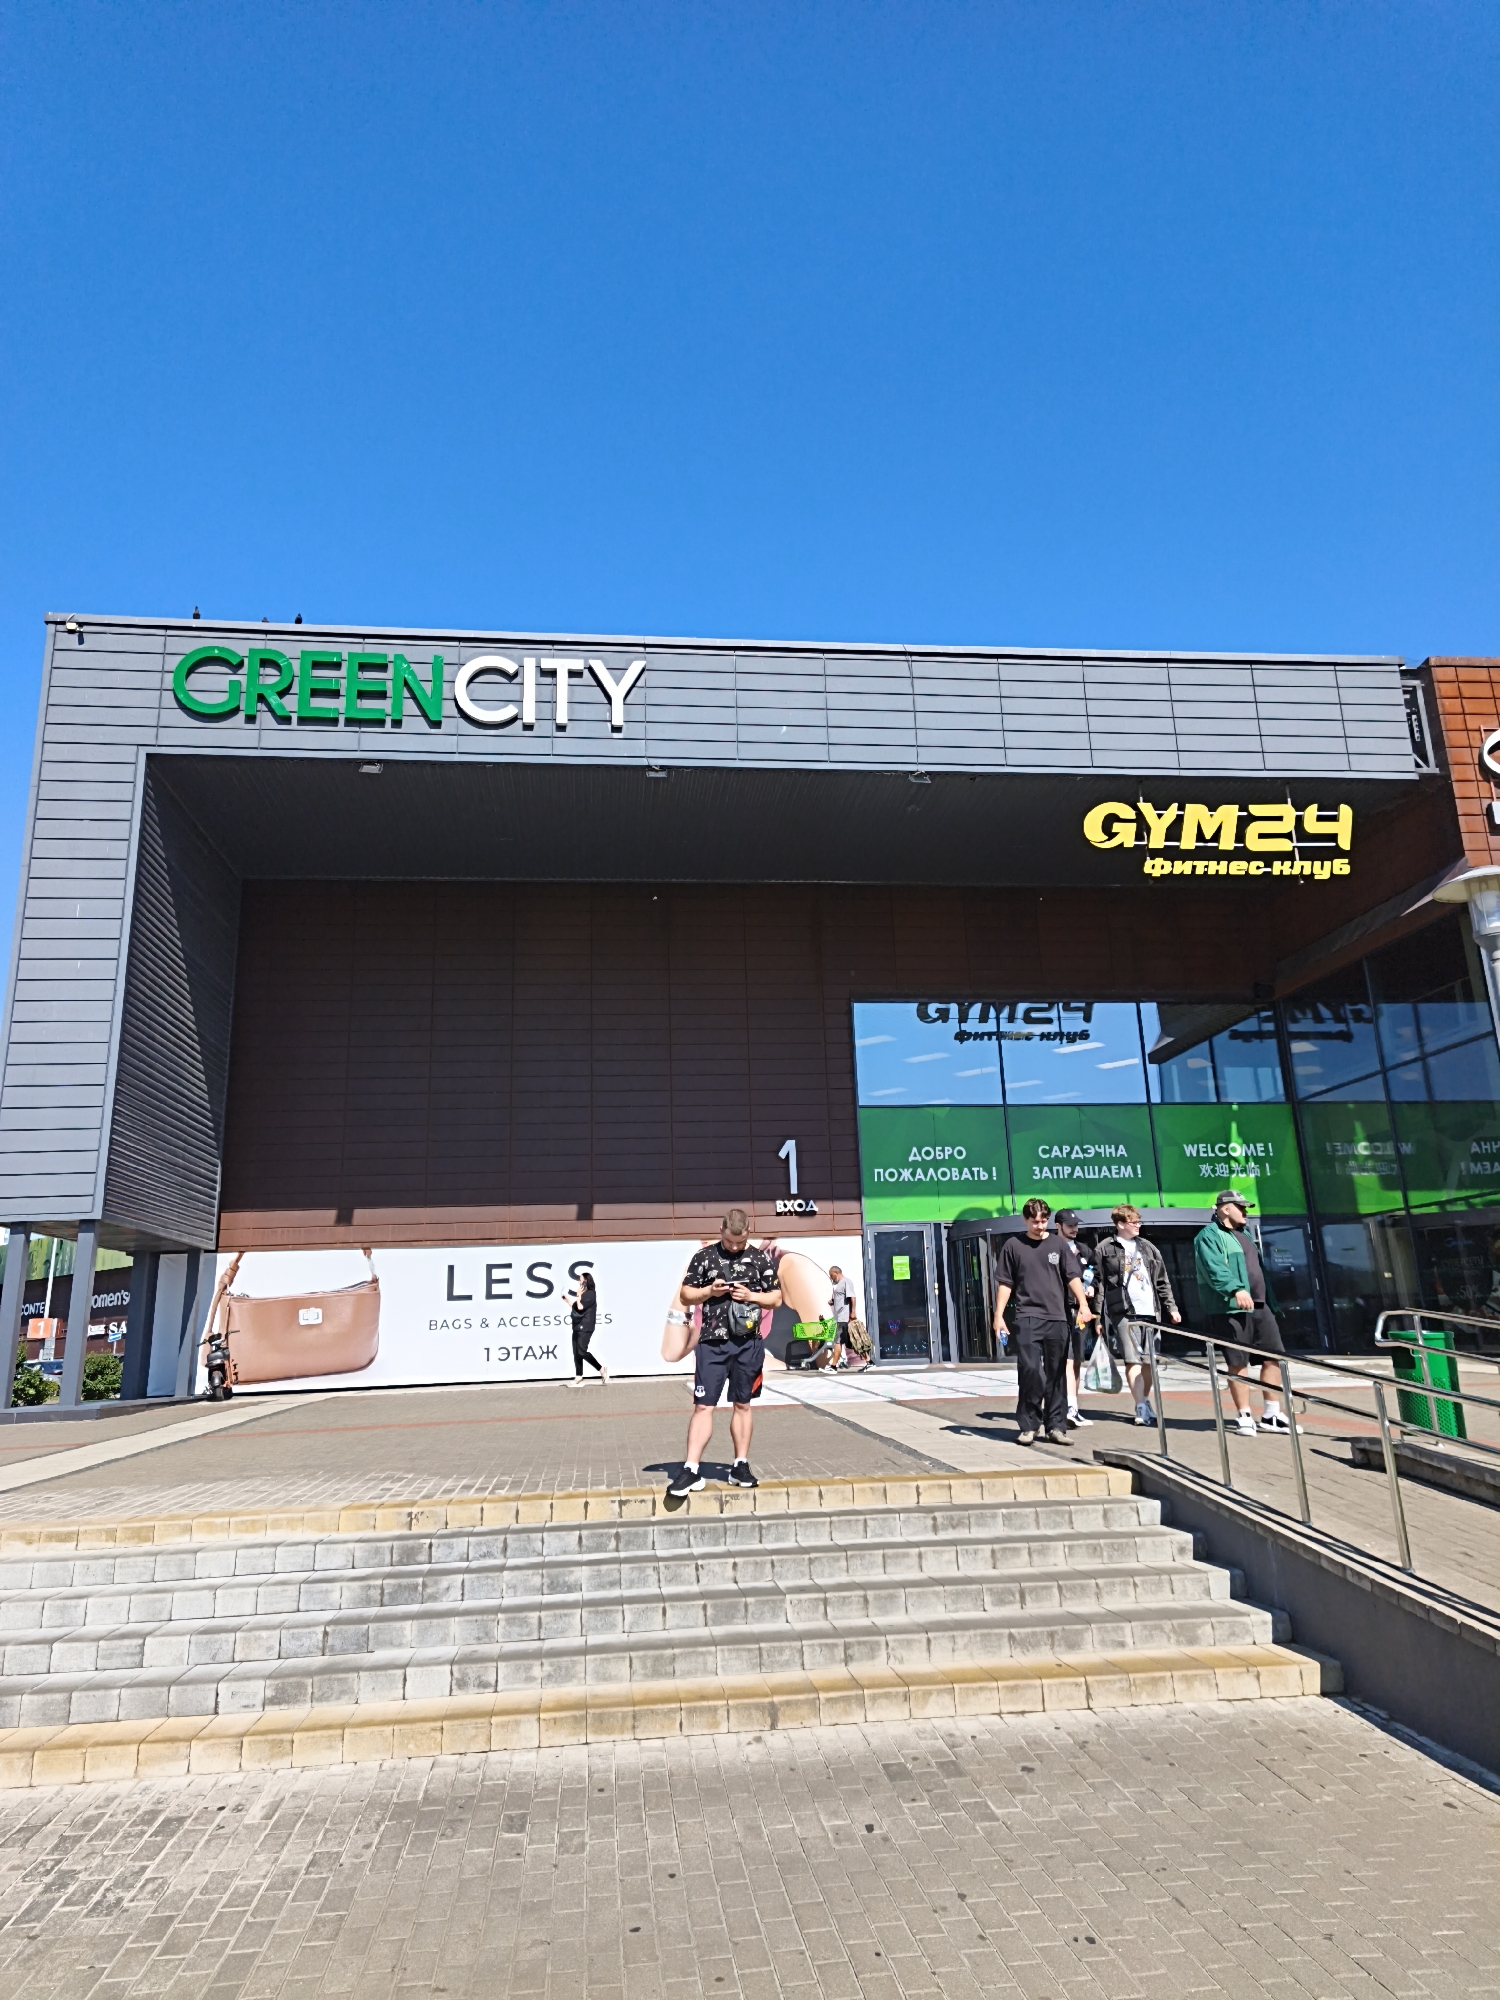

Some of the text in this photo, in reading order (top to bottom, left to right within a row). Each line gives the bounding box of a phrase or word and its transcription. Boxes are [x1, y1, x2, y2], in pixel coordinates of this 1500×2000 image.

[1083, 801, 1353, 852] GYM24
[908, 1146, 967, 1161] ДОБРО
[1038, 1144, 1128, 1160] САРДЭЧНА
[778, 1139, 798, 1194] 1
[775, 1199, 818, 1213] ВХОД
[446, 1260, 594, 1301] LESS
[37, 1320, 45, 1336] 1
[428, 1313, 613, 1331] BAGS & ACCESSOES
[484, 1344, 558, 1362] 1 ЭТАЖ
